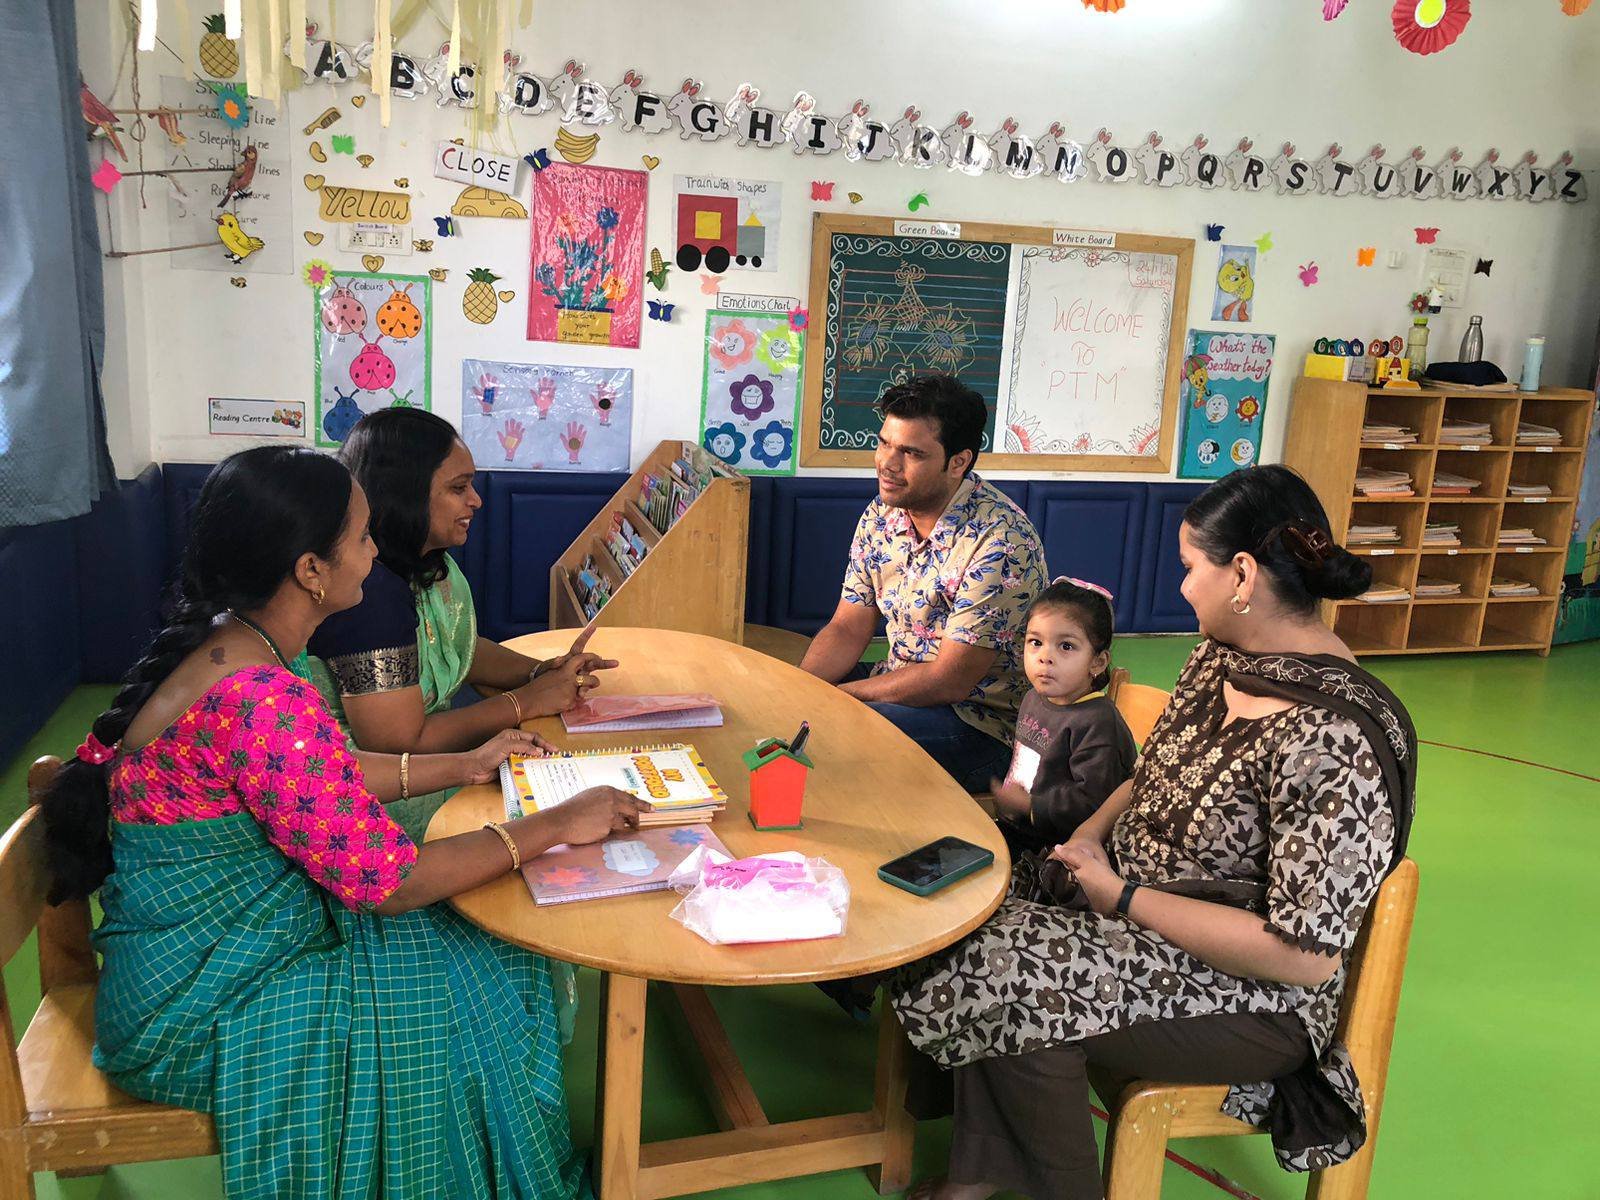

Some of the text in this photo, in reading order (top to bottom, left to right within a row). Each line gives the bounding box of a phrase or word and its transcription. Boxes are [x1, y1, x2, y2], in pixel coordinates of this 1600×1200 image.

[314, 41, 1582, 197] A B C D E F G H I J K L M N O P Q R S T U V W X Y Z
[199, 130, 241, 153] Sleeping
[442, 147, 511, 183] CLOSE
[737, 181, 767, 197] Shapes
[324, 186, 409, 221] Yellow
[900, 223, 928, 235] Green
[1056, 231, 1113, 245] White Board
[354, 280, 385, 292] Colours
[721, 295, 791, 311] Emotions Chart
[1251, 340, 1267, 354] the
[212, 412, 270, 424] Reading Centre
